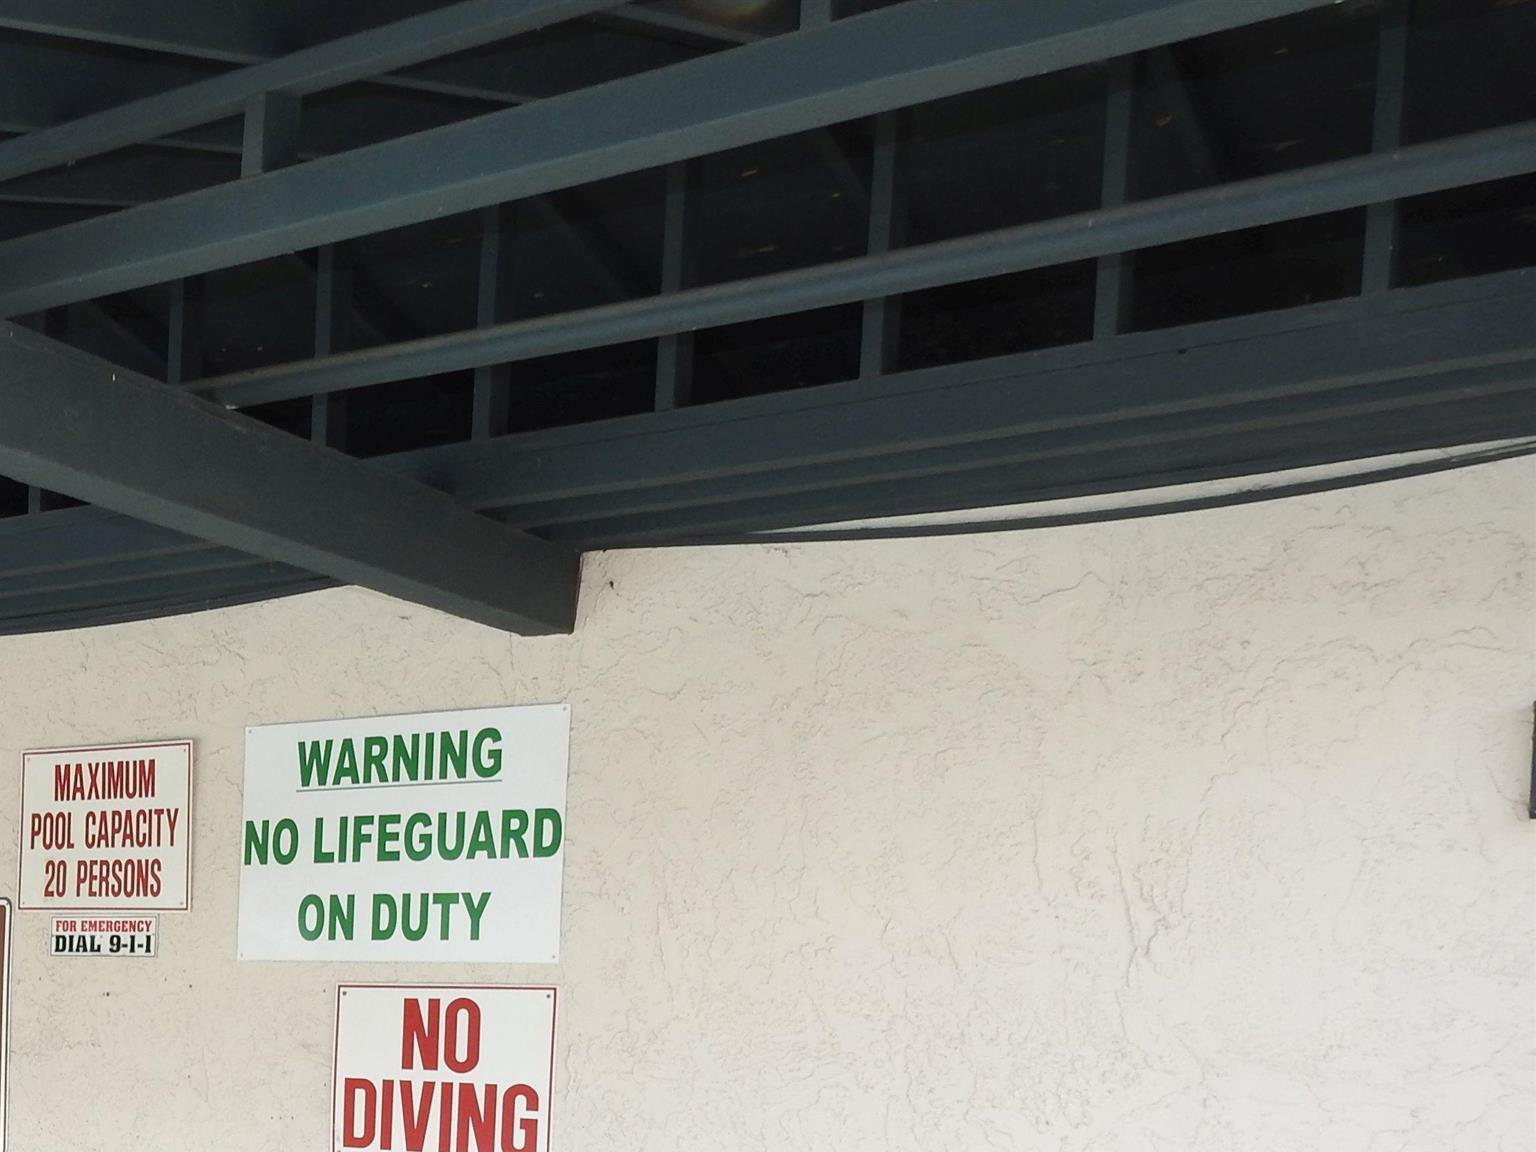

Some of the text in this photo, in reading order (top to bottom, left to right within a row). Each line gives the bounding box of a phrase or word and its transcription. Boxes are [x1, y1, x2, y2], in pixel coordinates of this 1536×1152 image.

[297, 727, 503, 788] WARNING
[54, 759, 156, 801] MAXIMUM
[30, 808, 179, 850] POOL CAPACITY
[243, 807, 563, 866] NO LIFEGUARD
[43, 858, 162, 898] 20 PERSONS
[55, 920, 153, 932] FOR EMERGENCY
[297, 892, 492, 942] ON DUTY
[54, 934, 152, 954] DIAL 9-1-1
[401, 998, 482, 1074] NO
